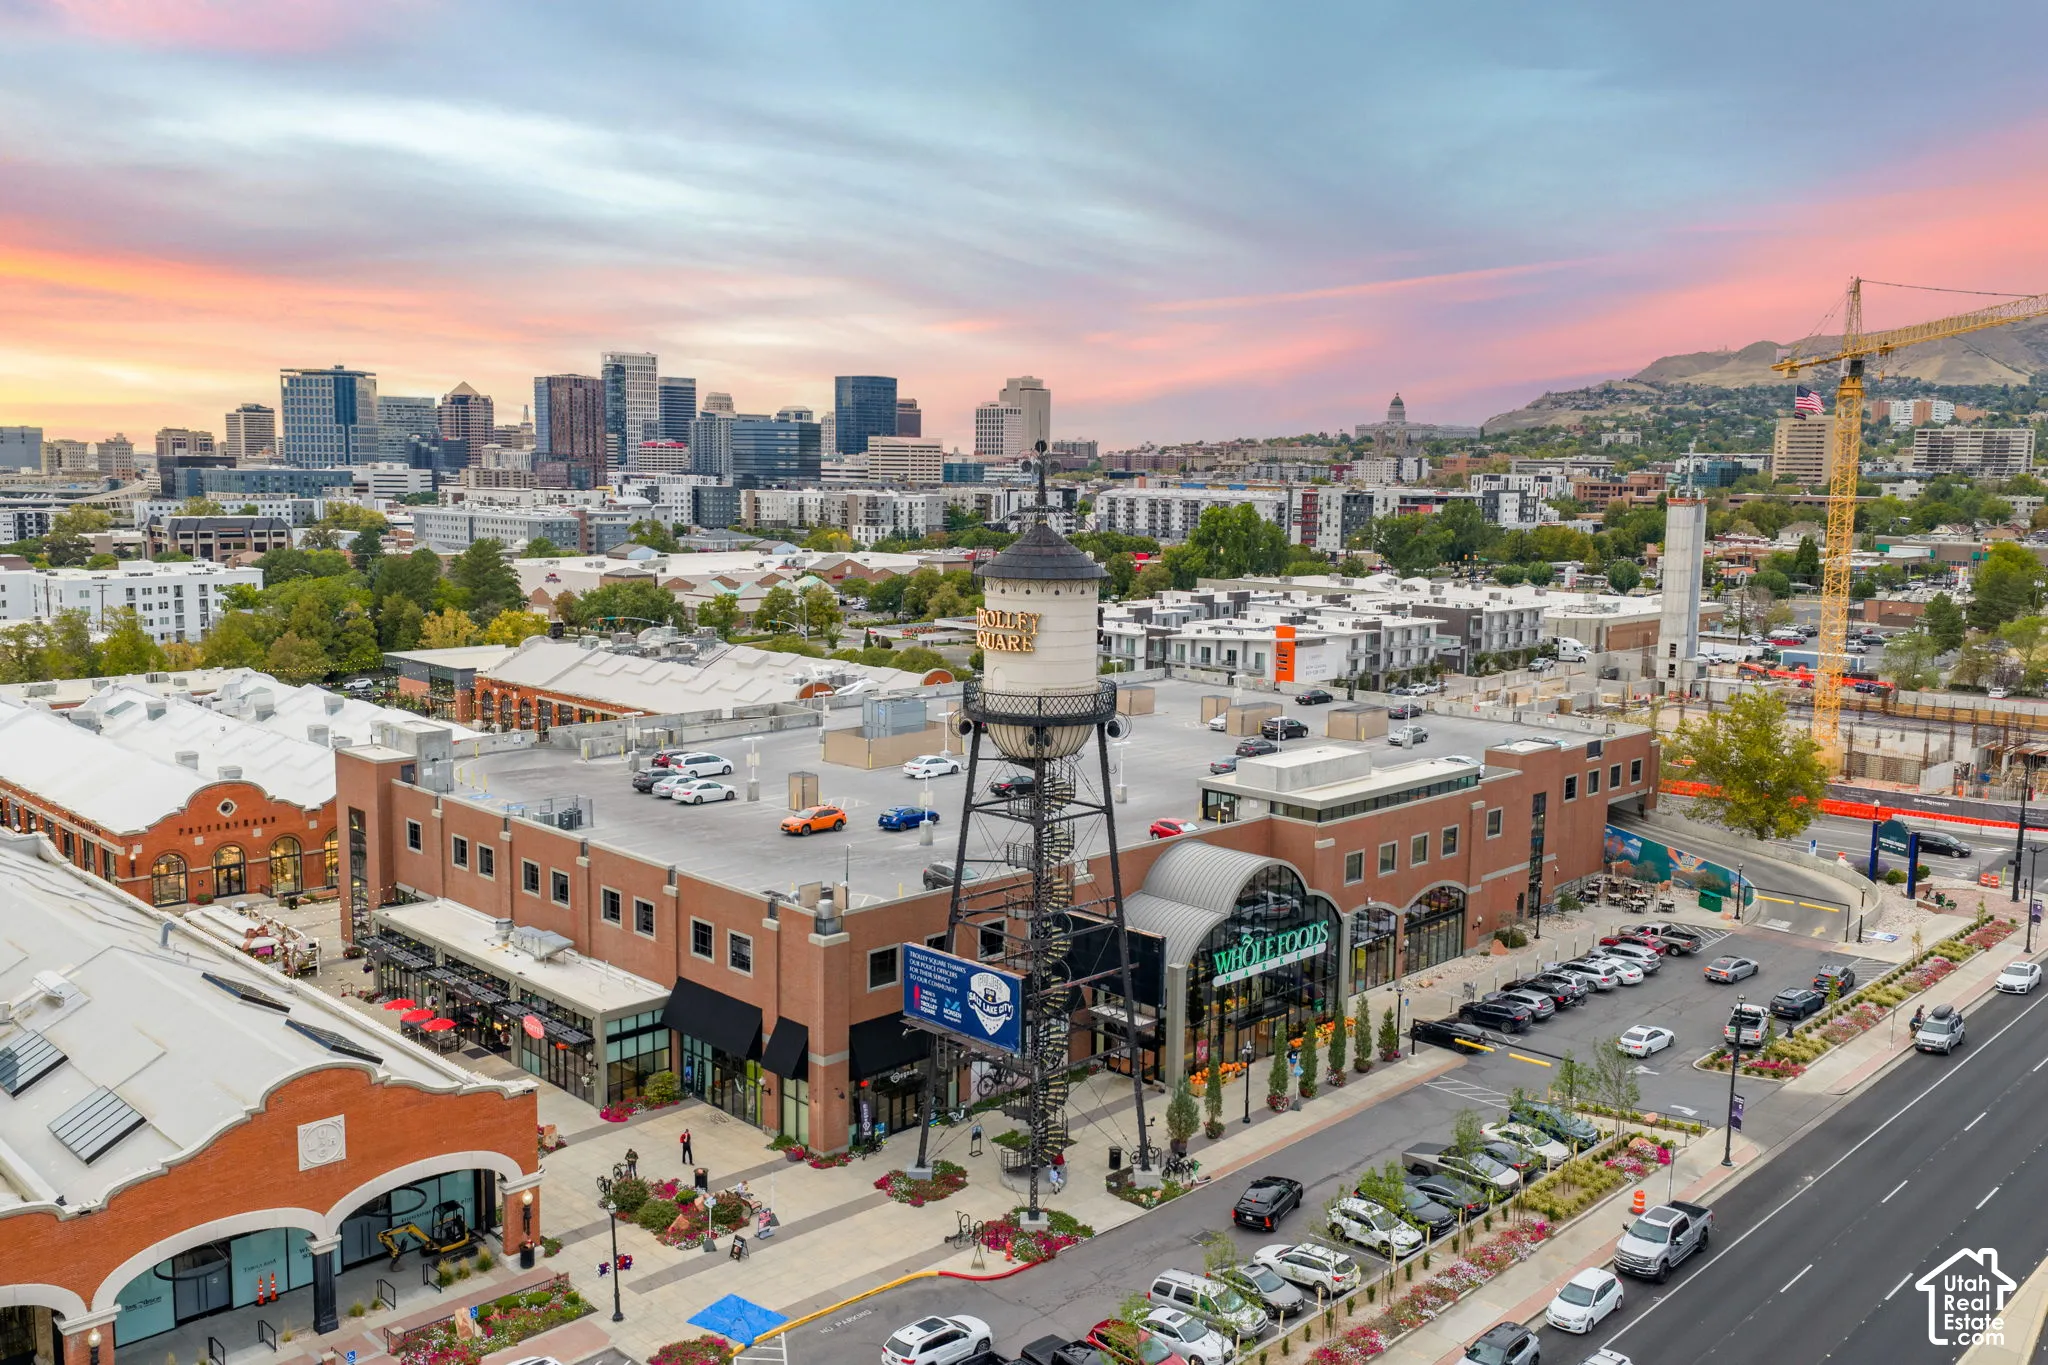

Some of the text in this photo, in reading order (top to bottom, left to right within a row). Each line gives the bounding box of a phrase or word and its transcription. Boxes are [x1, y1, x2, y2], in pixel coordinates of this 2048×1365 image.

[1213, 920, 1329, 975] WHOLE FOODS
[1224, 946, 1317, 983] MARKET
[968, 991, 982, 1007] SALT
[982, 1002, 998, 1015] LAKE
[998, 1003, 1013, 1014] CITY
